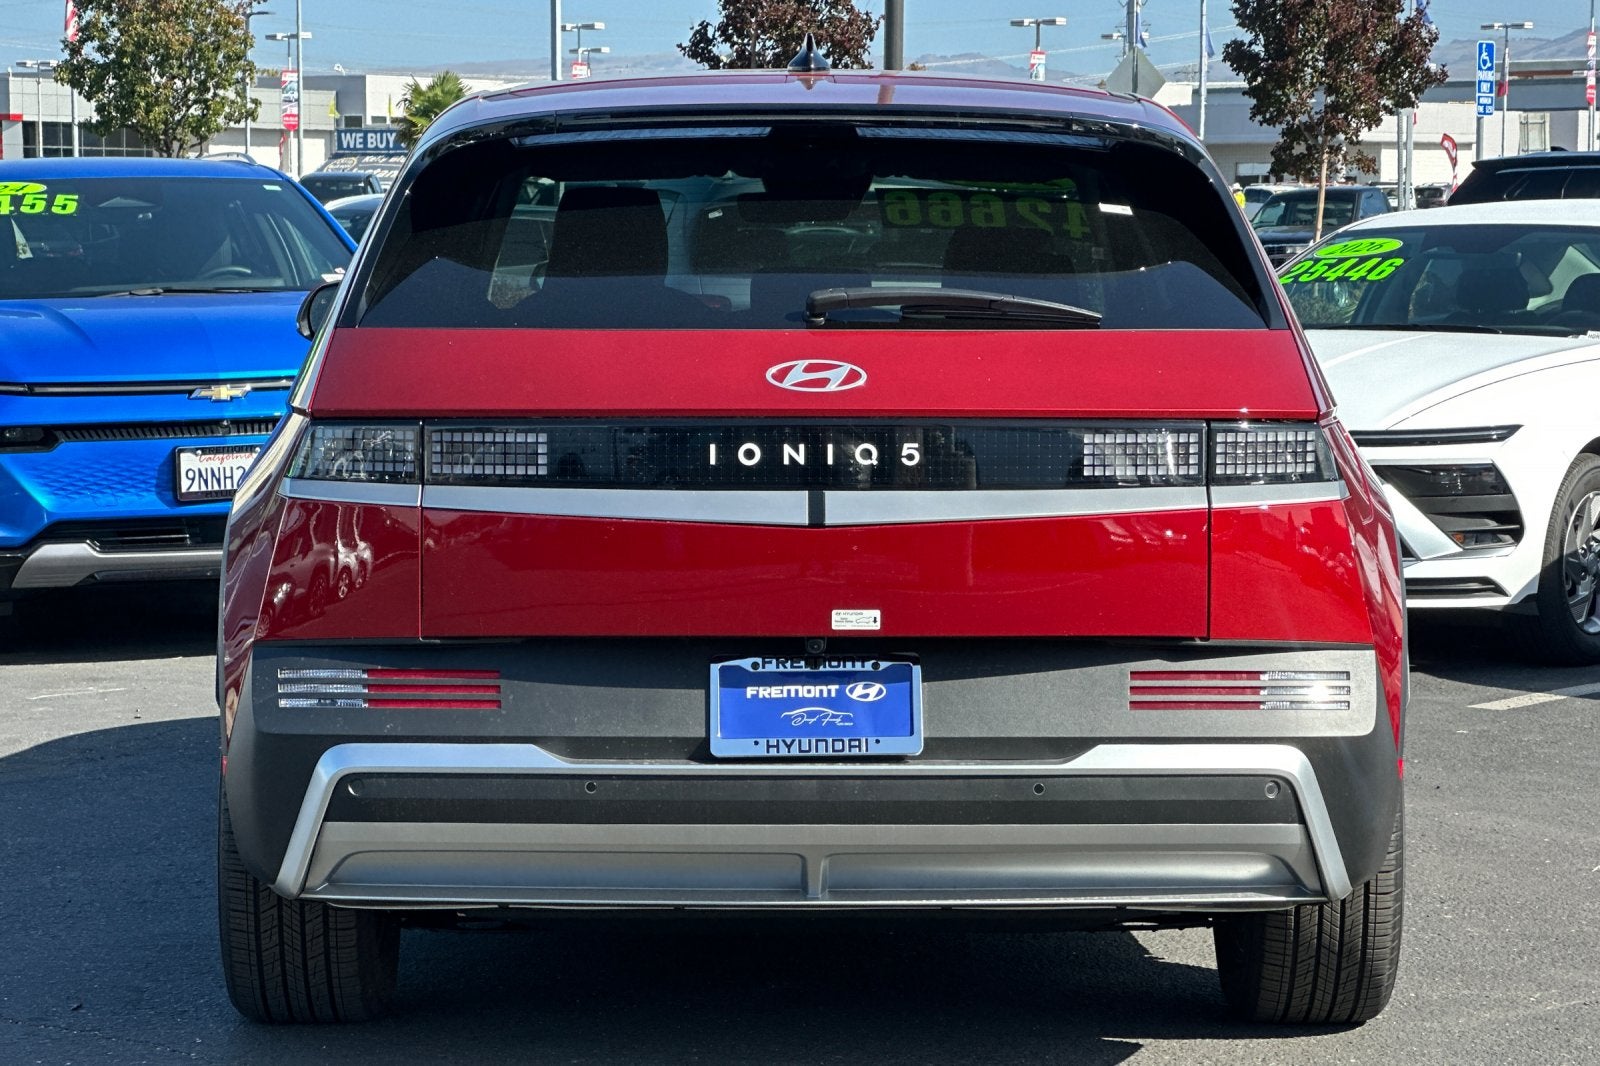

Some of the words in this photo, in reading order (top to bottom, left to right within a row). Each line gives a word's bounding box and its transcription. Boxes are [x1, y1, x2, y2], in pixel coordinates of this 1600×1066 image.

[341, 132, 364, 149] WE
[367, 132, 397, 149] BUY
[1324, 241, 1391, 255] 2026
[1279, 258, 1404, 285] 25446
[709, 442, 878, 466] IONIQ
[900, 442, 920, 466] 5
[746, 685, 840, 699] FREMONT
[766, 738, 869, 754] HYUNDAI
